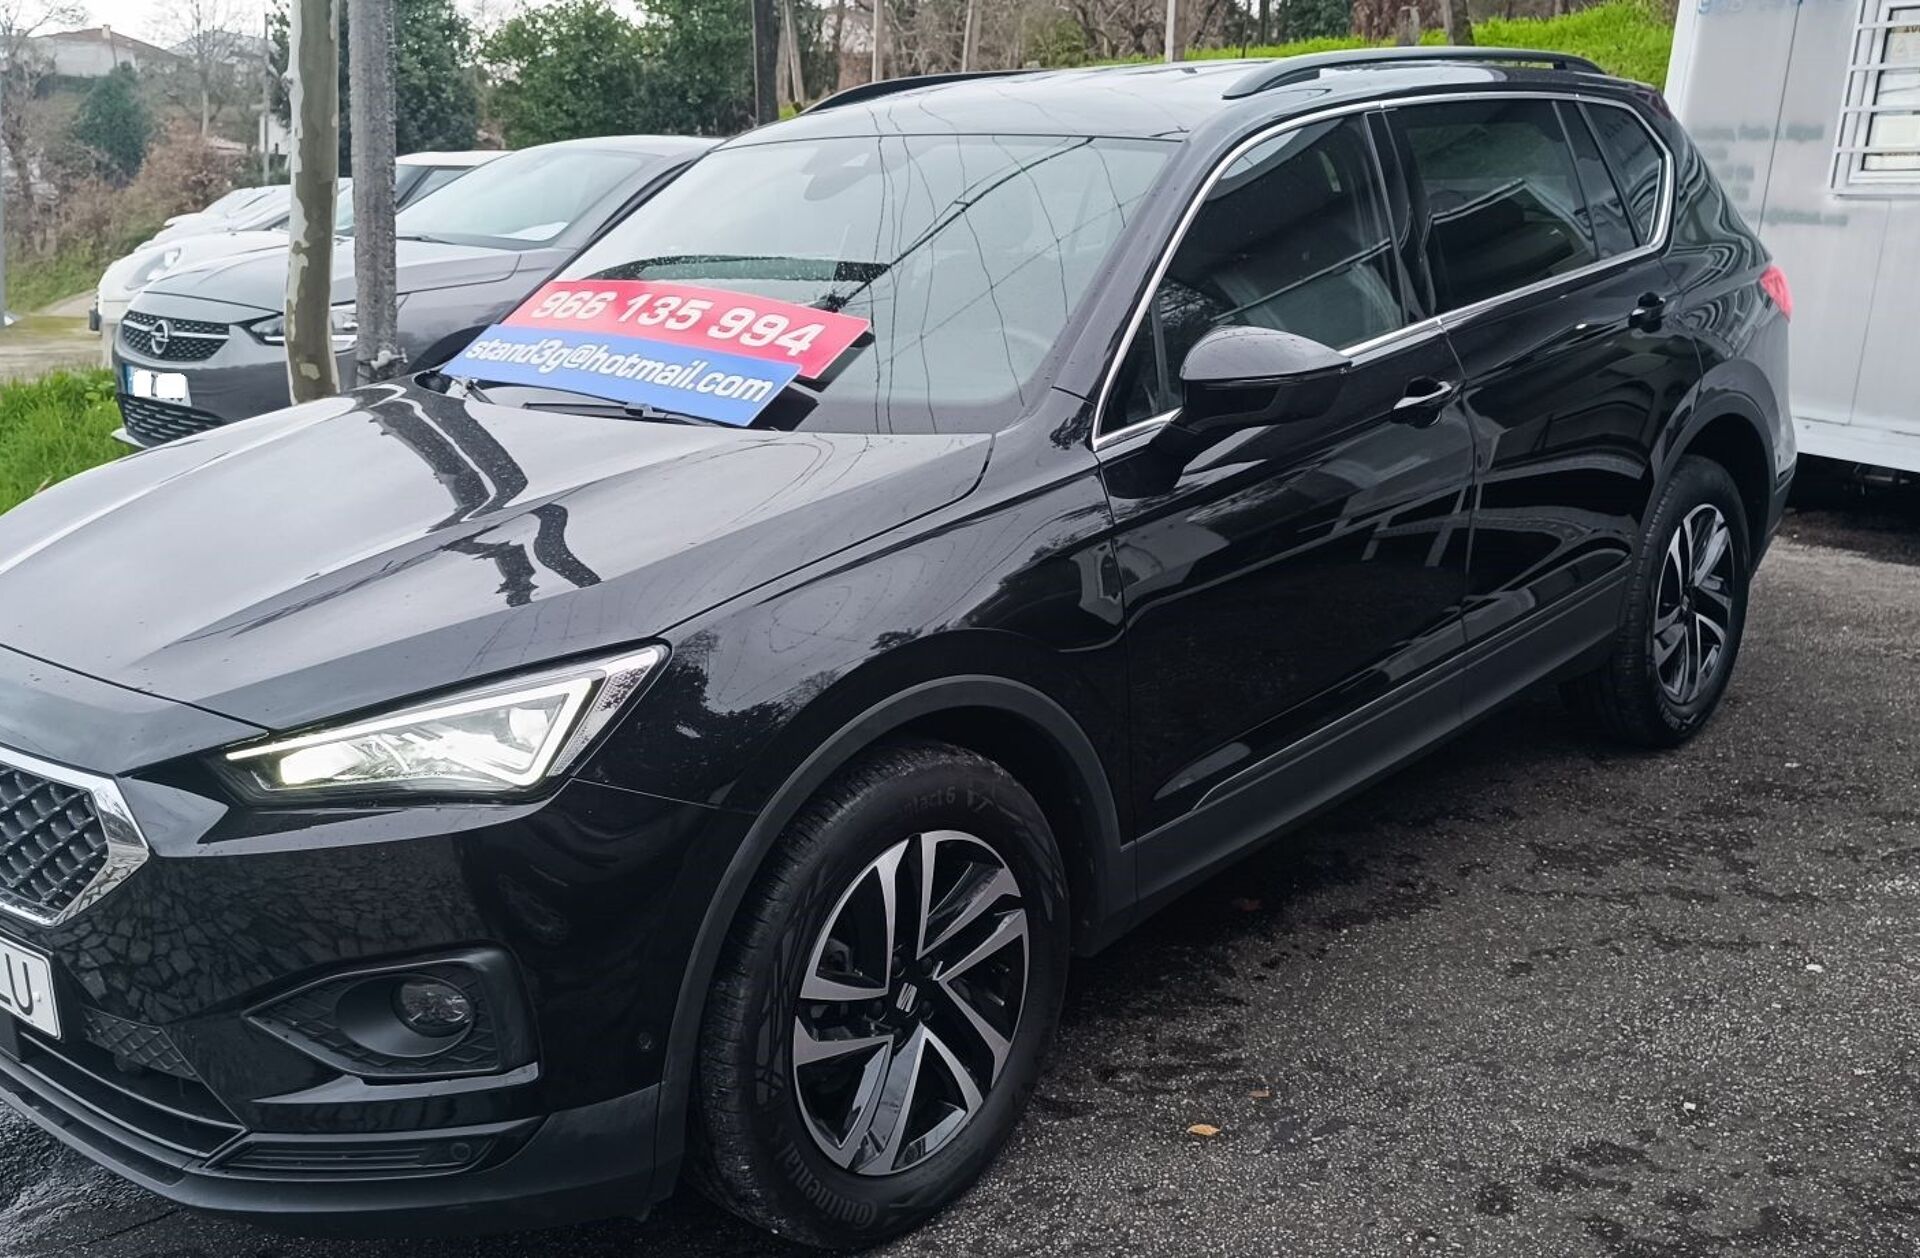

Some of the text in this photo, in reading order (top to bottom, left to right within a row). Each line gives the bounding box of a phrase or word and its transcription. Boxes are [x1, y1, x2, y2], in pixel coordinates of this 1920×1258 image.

[531, 291, 826, 356] 966 135 994
[465, 338, 774, 402] stand3g@hotmail.com
